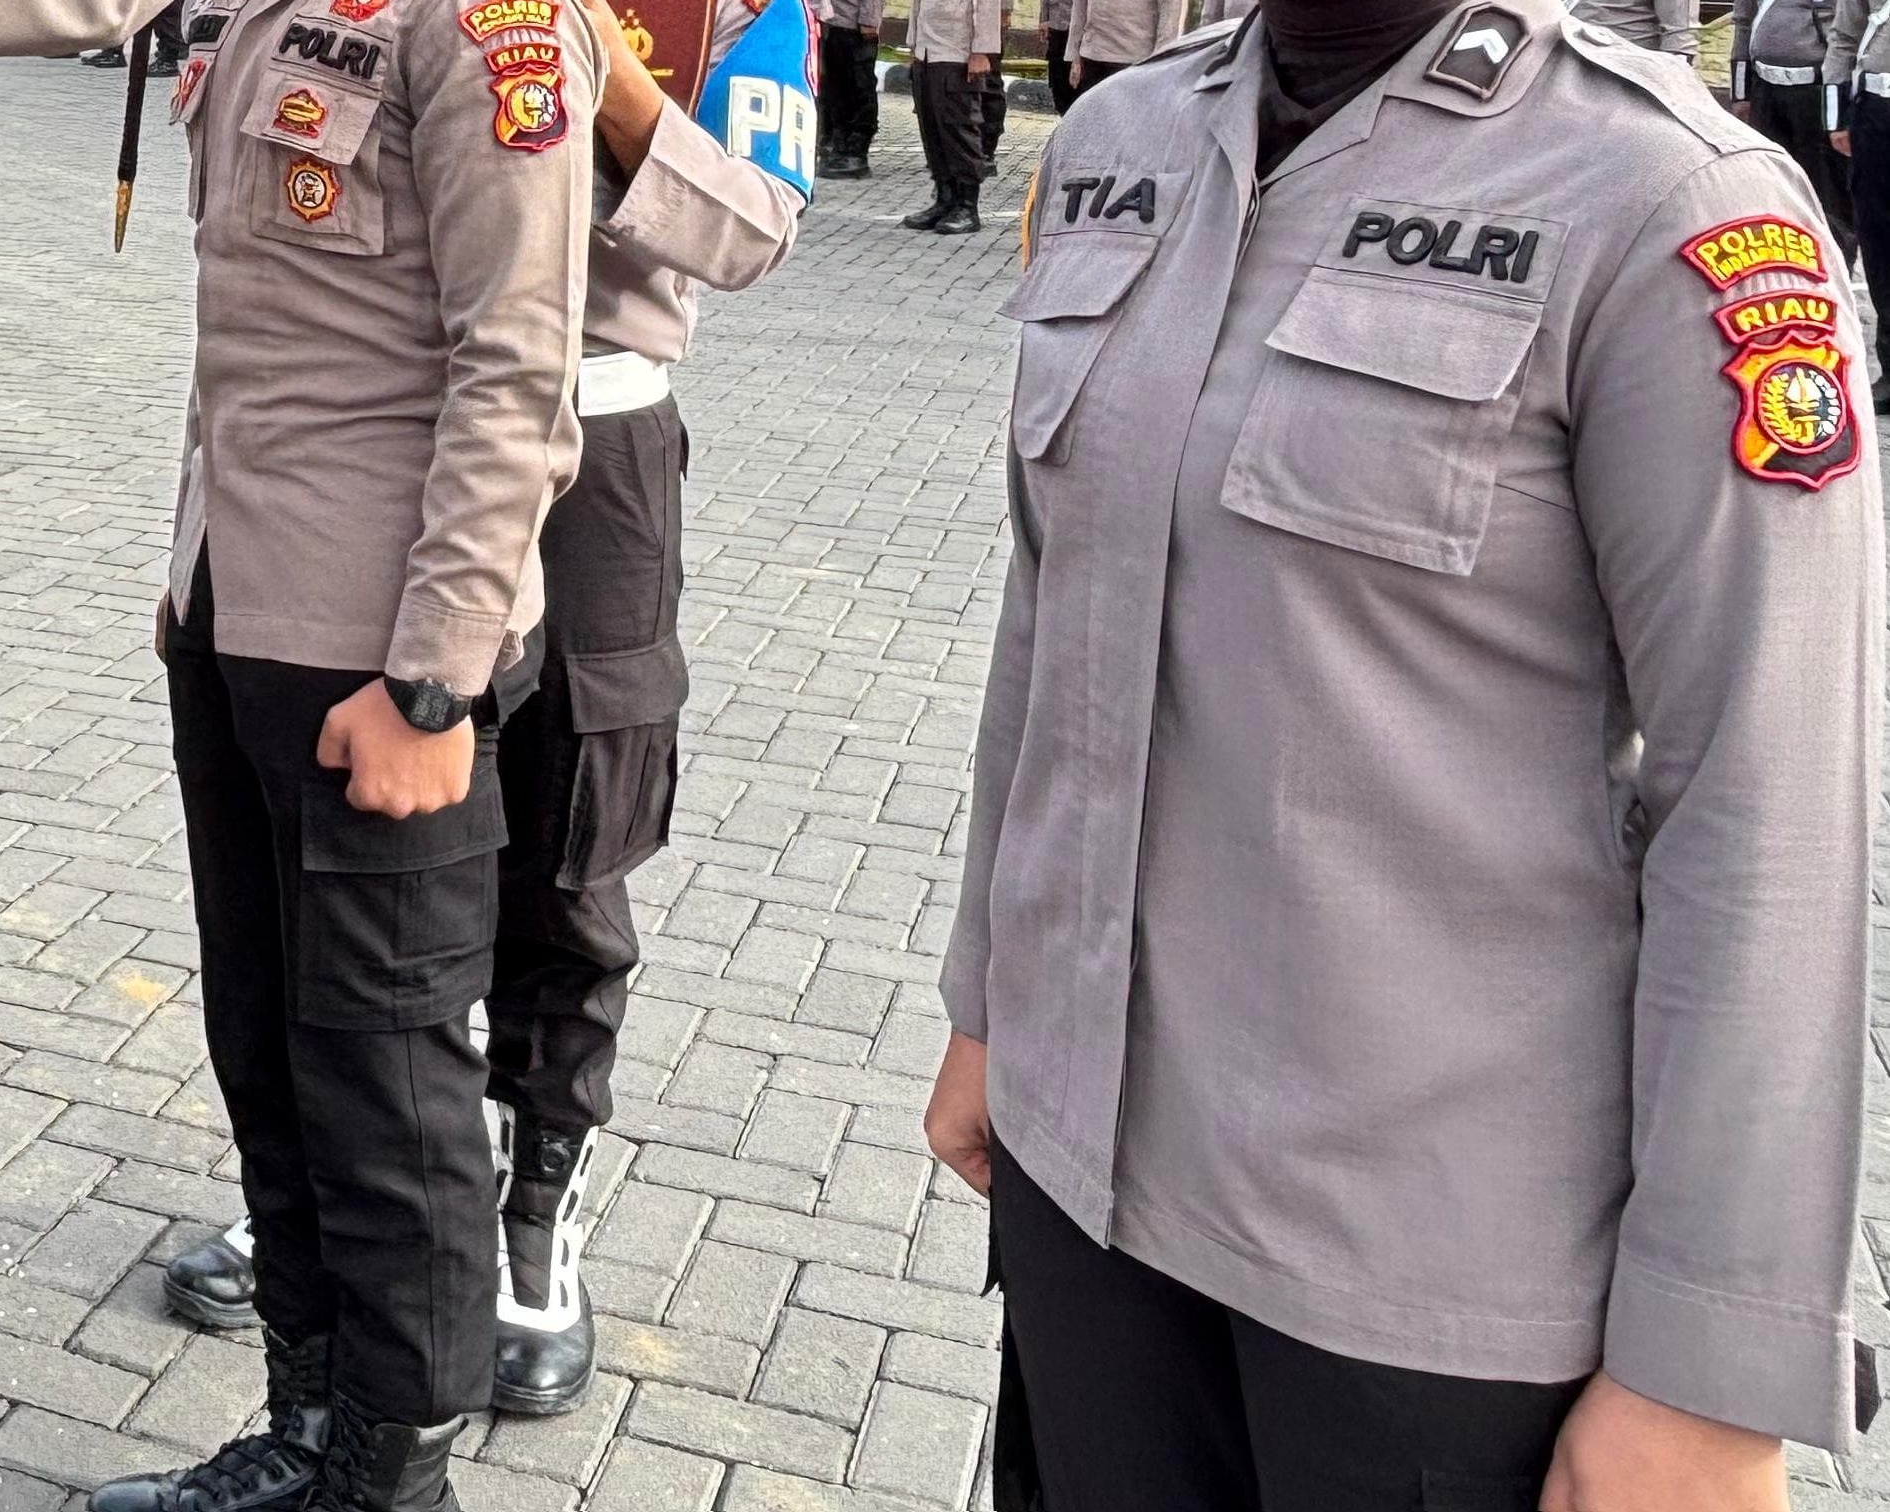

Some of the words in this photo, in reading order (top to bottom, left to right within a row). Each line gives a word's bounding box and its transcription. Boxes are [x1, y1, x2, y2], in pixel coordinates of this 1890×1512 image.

[279, 22, 380, 80] POLRI
[497, 47, 554, 67] RIAU
[1061, 176, 1157, 224] TIA
[1342, 211, 1540, 283] POLRI
[1696, 223, 1816, 269] POLRES
[1735, 298, 1829, 332] RIAU
